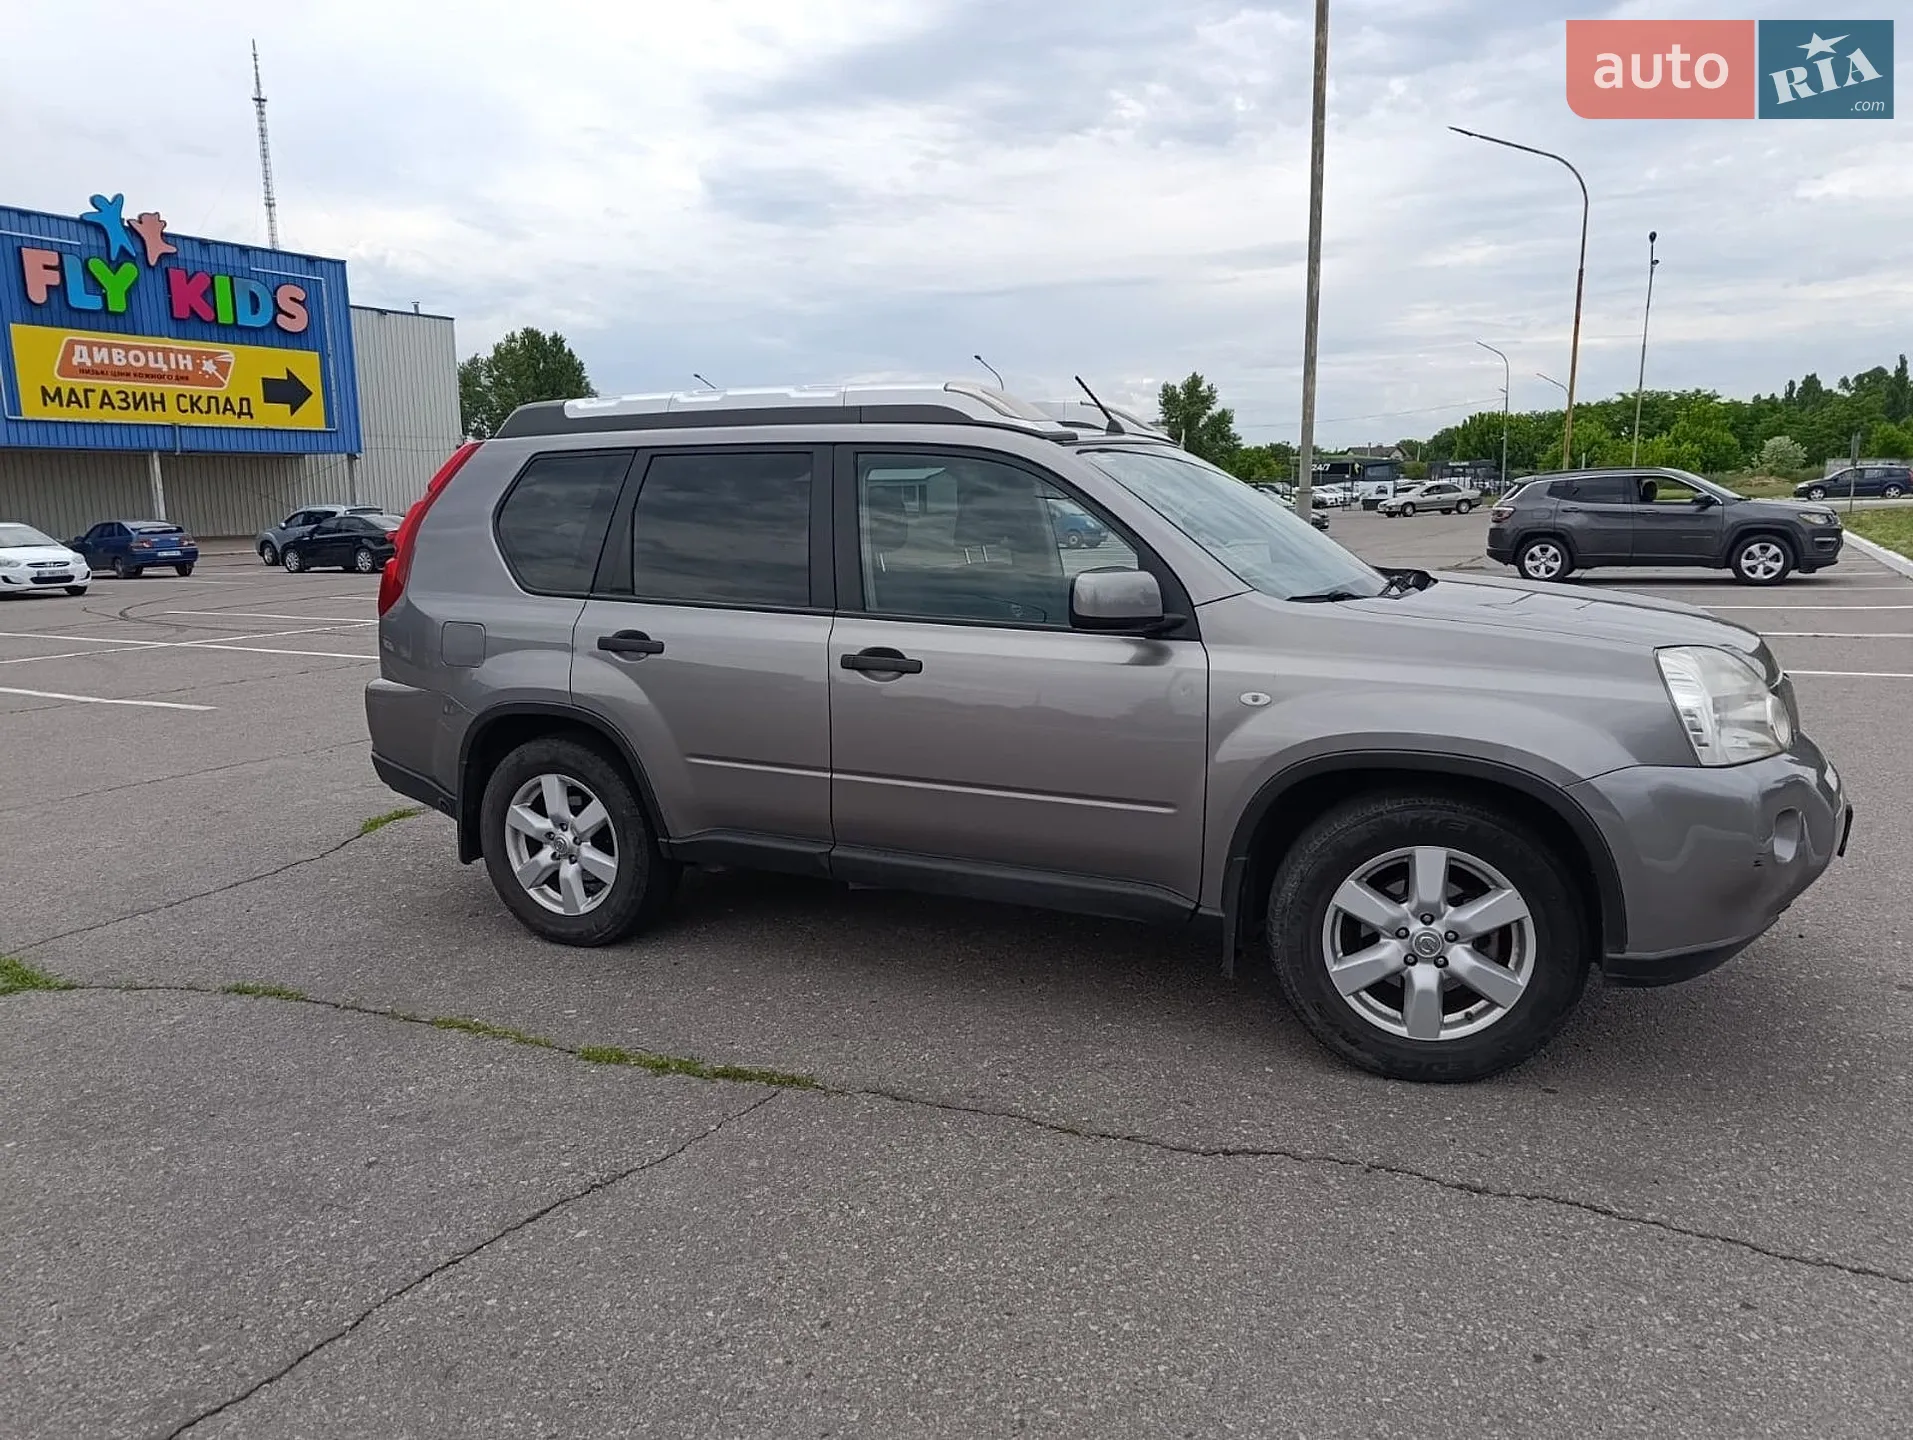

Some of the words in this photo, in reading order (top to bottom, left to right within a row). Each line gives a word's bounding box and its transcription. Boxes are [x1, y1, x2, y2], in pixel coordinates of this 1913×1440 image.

[21, 247, 139, 313] FLY
[166, 267, 309, 333] KIDS
[72, 344, 193, 371] ДИВОЦІН
[40, 385, 166, 412] МАГАЗИН
[176, 393, 254, 419] СКЛАД
